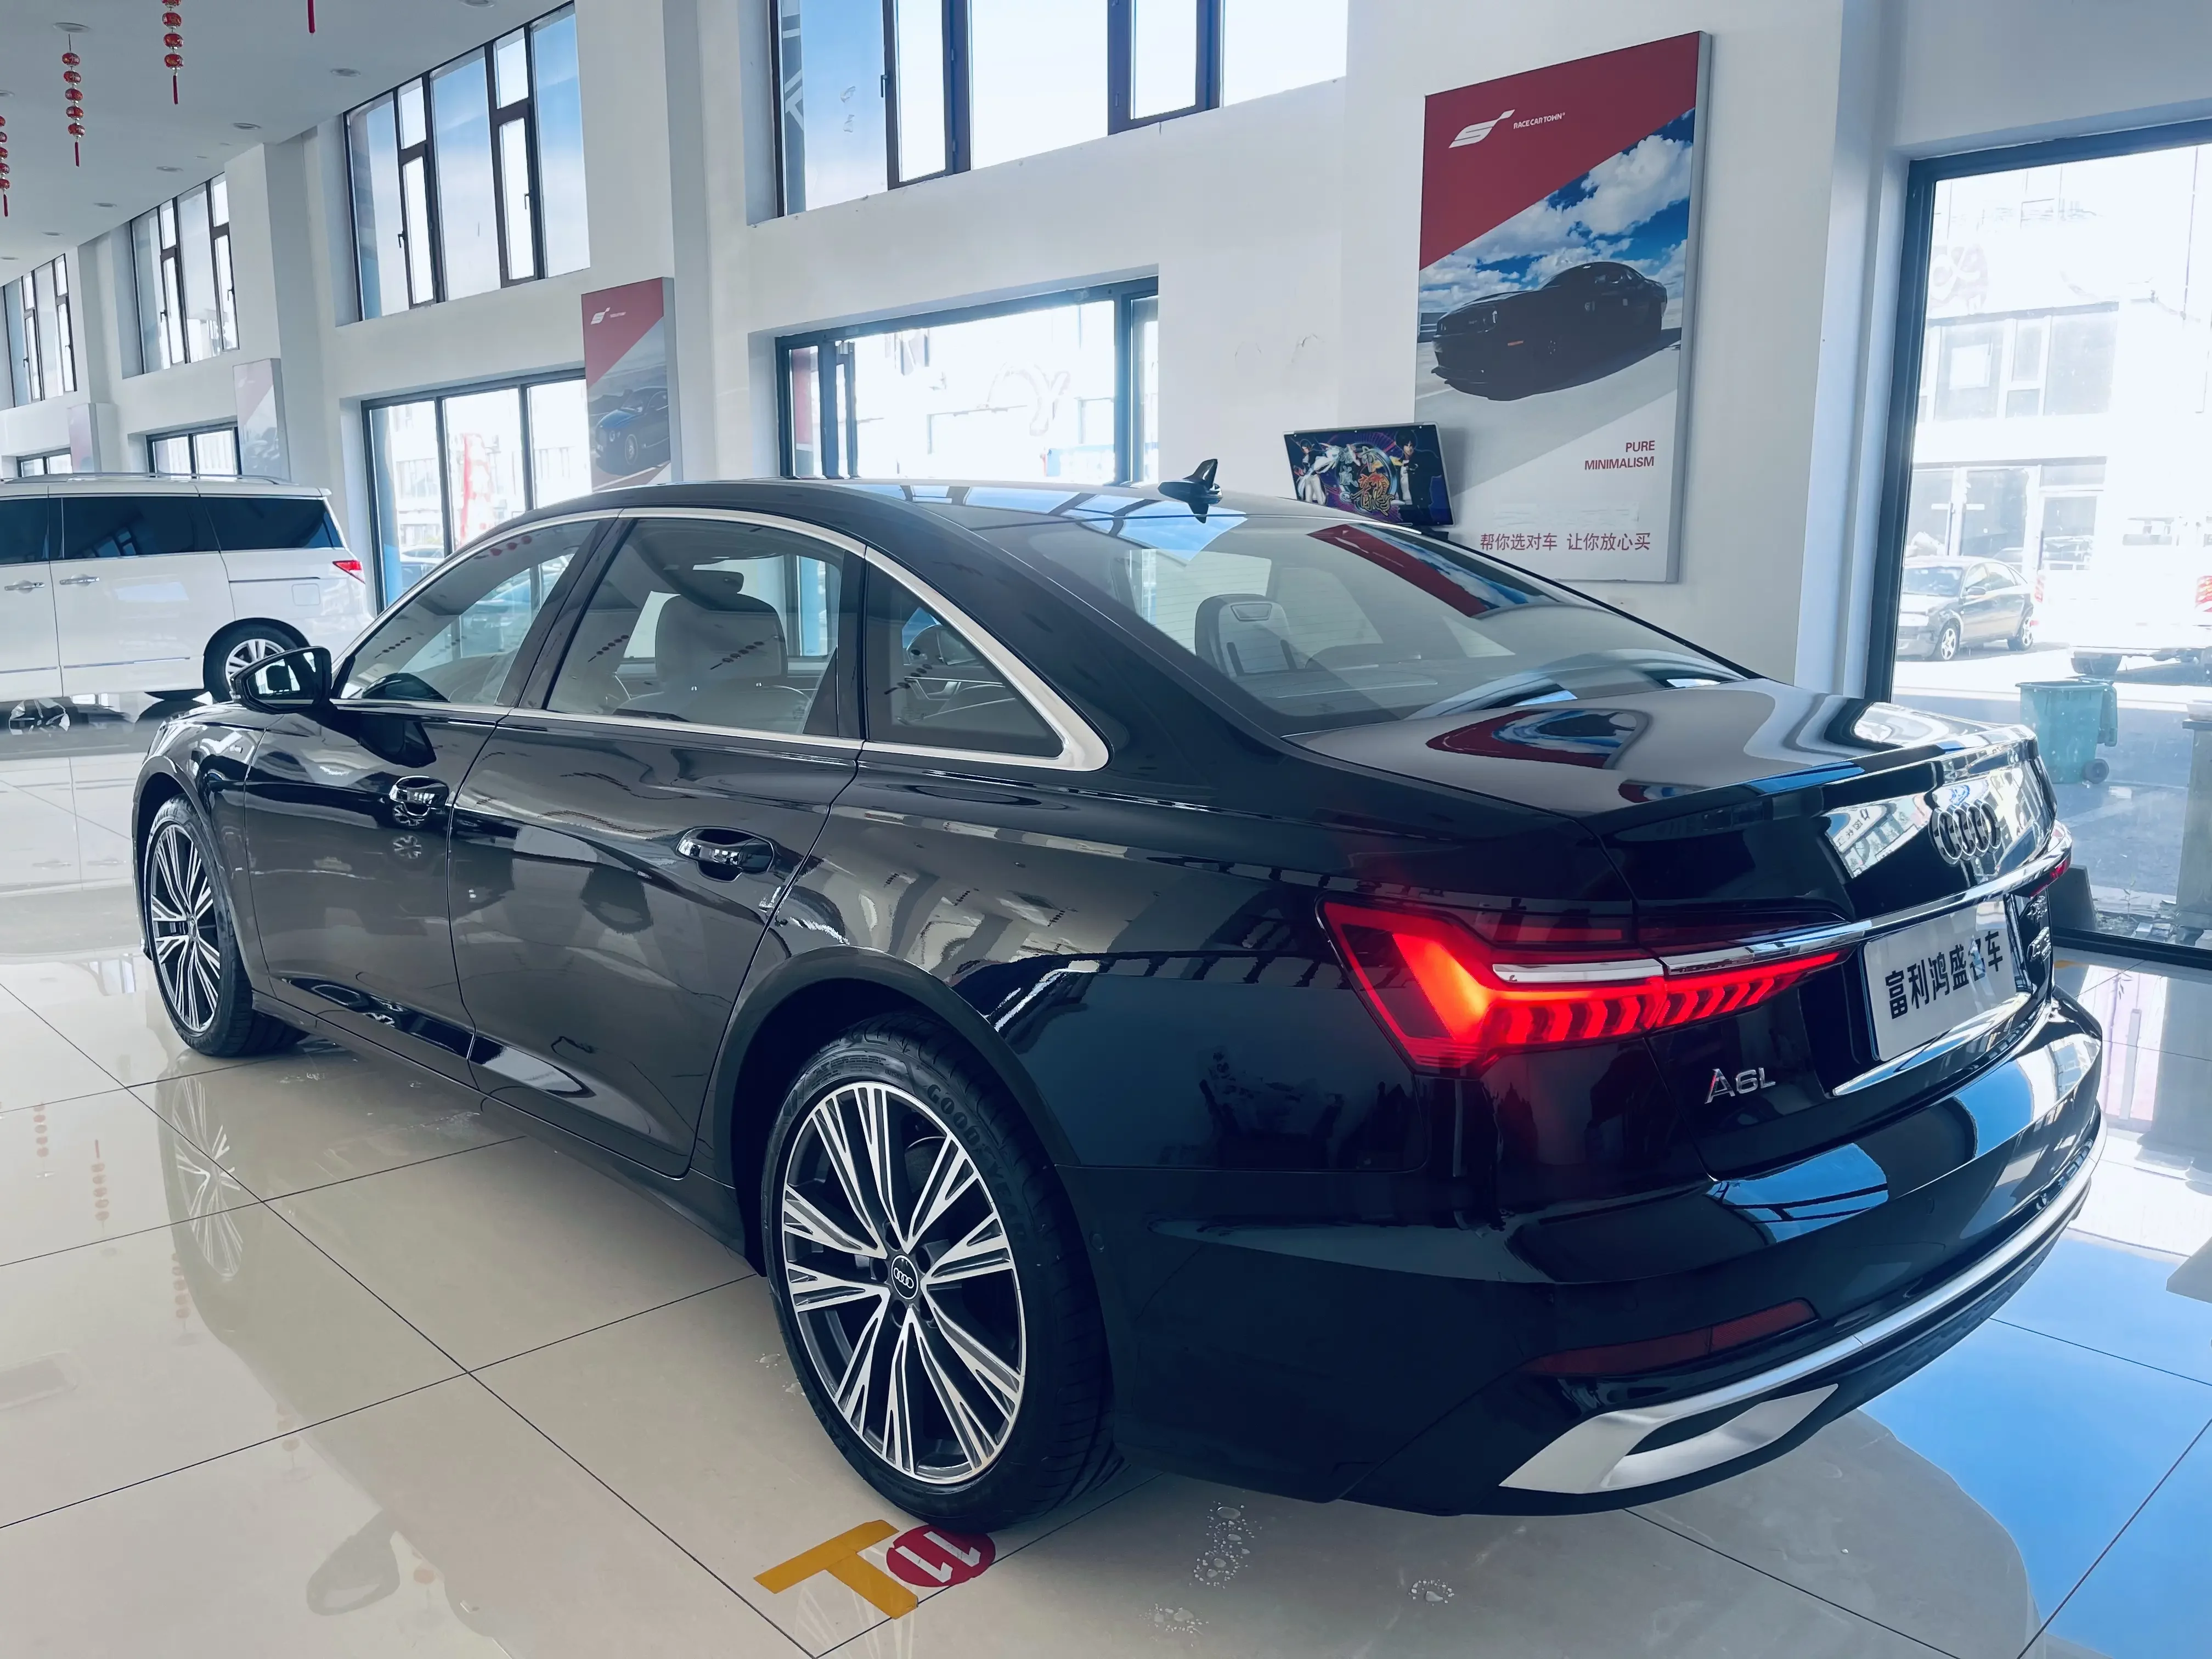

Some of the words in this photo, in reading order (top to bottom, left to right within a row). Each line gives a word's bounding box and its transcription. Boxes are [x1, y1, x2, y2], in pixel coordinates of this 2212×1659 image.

[1513, 120, 1530, 129] RACE
[1530, 117, 1543, 126] CAR
[1625, 440, 1655, 453] PURE
[1584, 455, 1655, 470] MINIMALISM
[1480, 533, 1558, 551] 帮你选对车
[1566, 532, 1651, 551] 让你放心买
[1704, 1067, 1776, 1104] A6L
